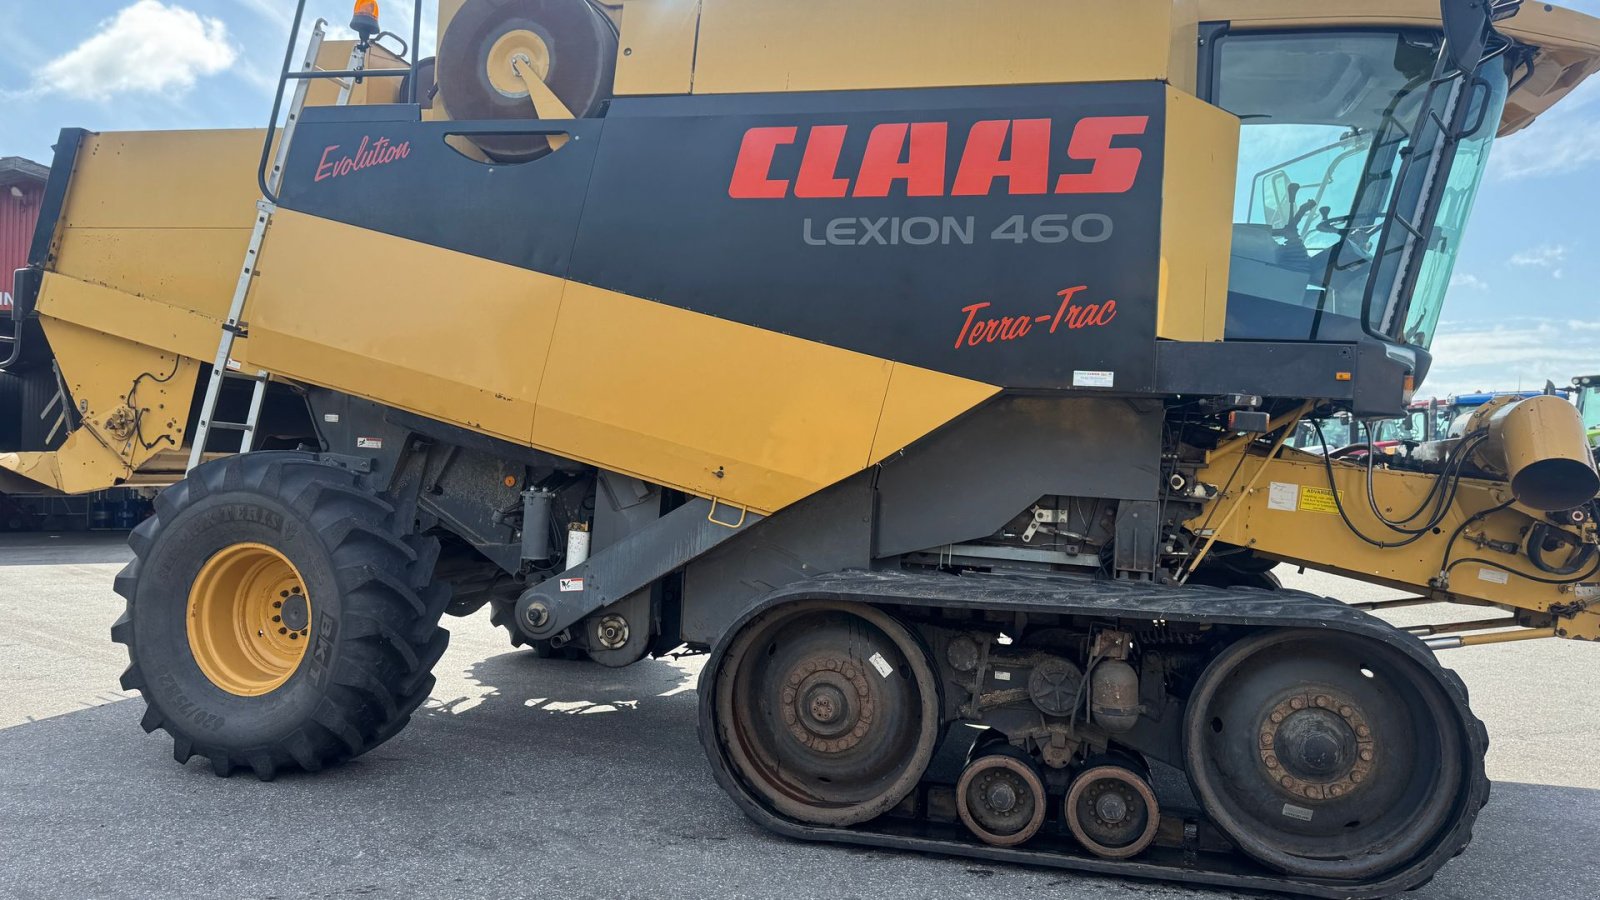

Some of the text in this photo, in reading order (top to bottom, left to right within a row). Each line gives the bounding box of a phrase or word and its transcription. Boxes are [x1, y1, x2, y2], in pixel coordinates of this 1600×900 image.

[314, 136, 410, 182] Evolution
[728, 115, 1150, 199] CLAAS
[803, 213, 1114, 245] LEXION 460
[309, 614, 333, 687] BKT
